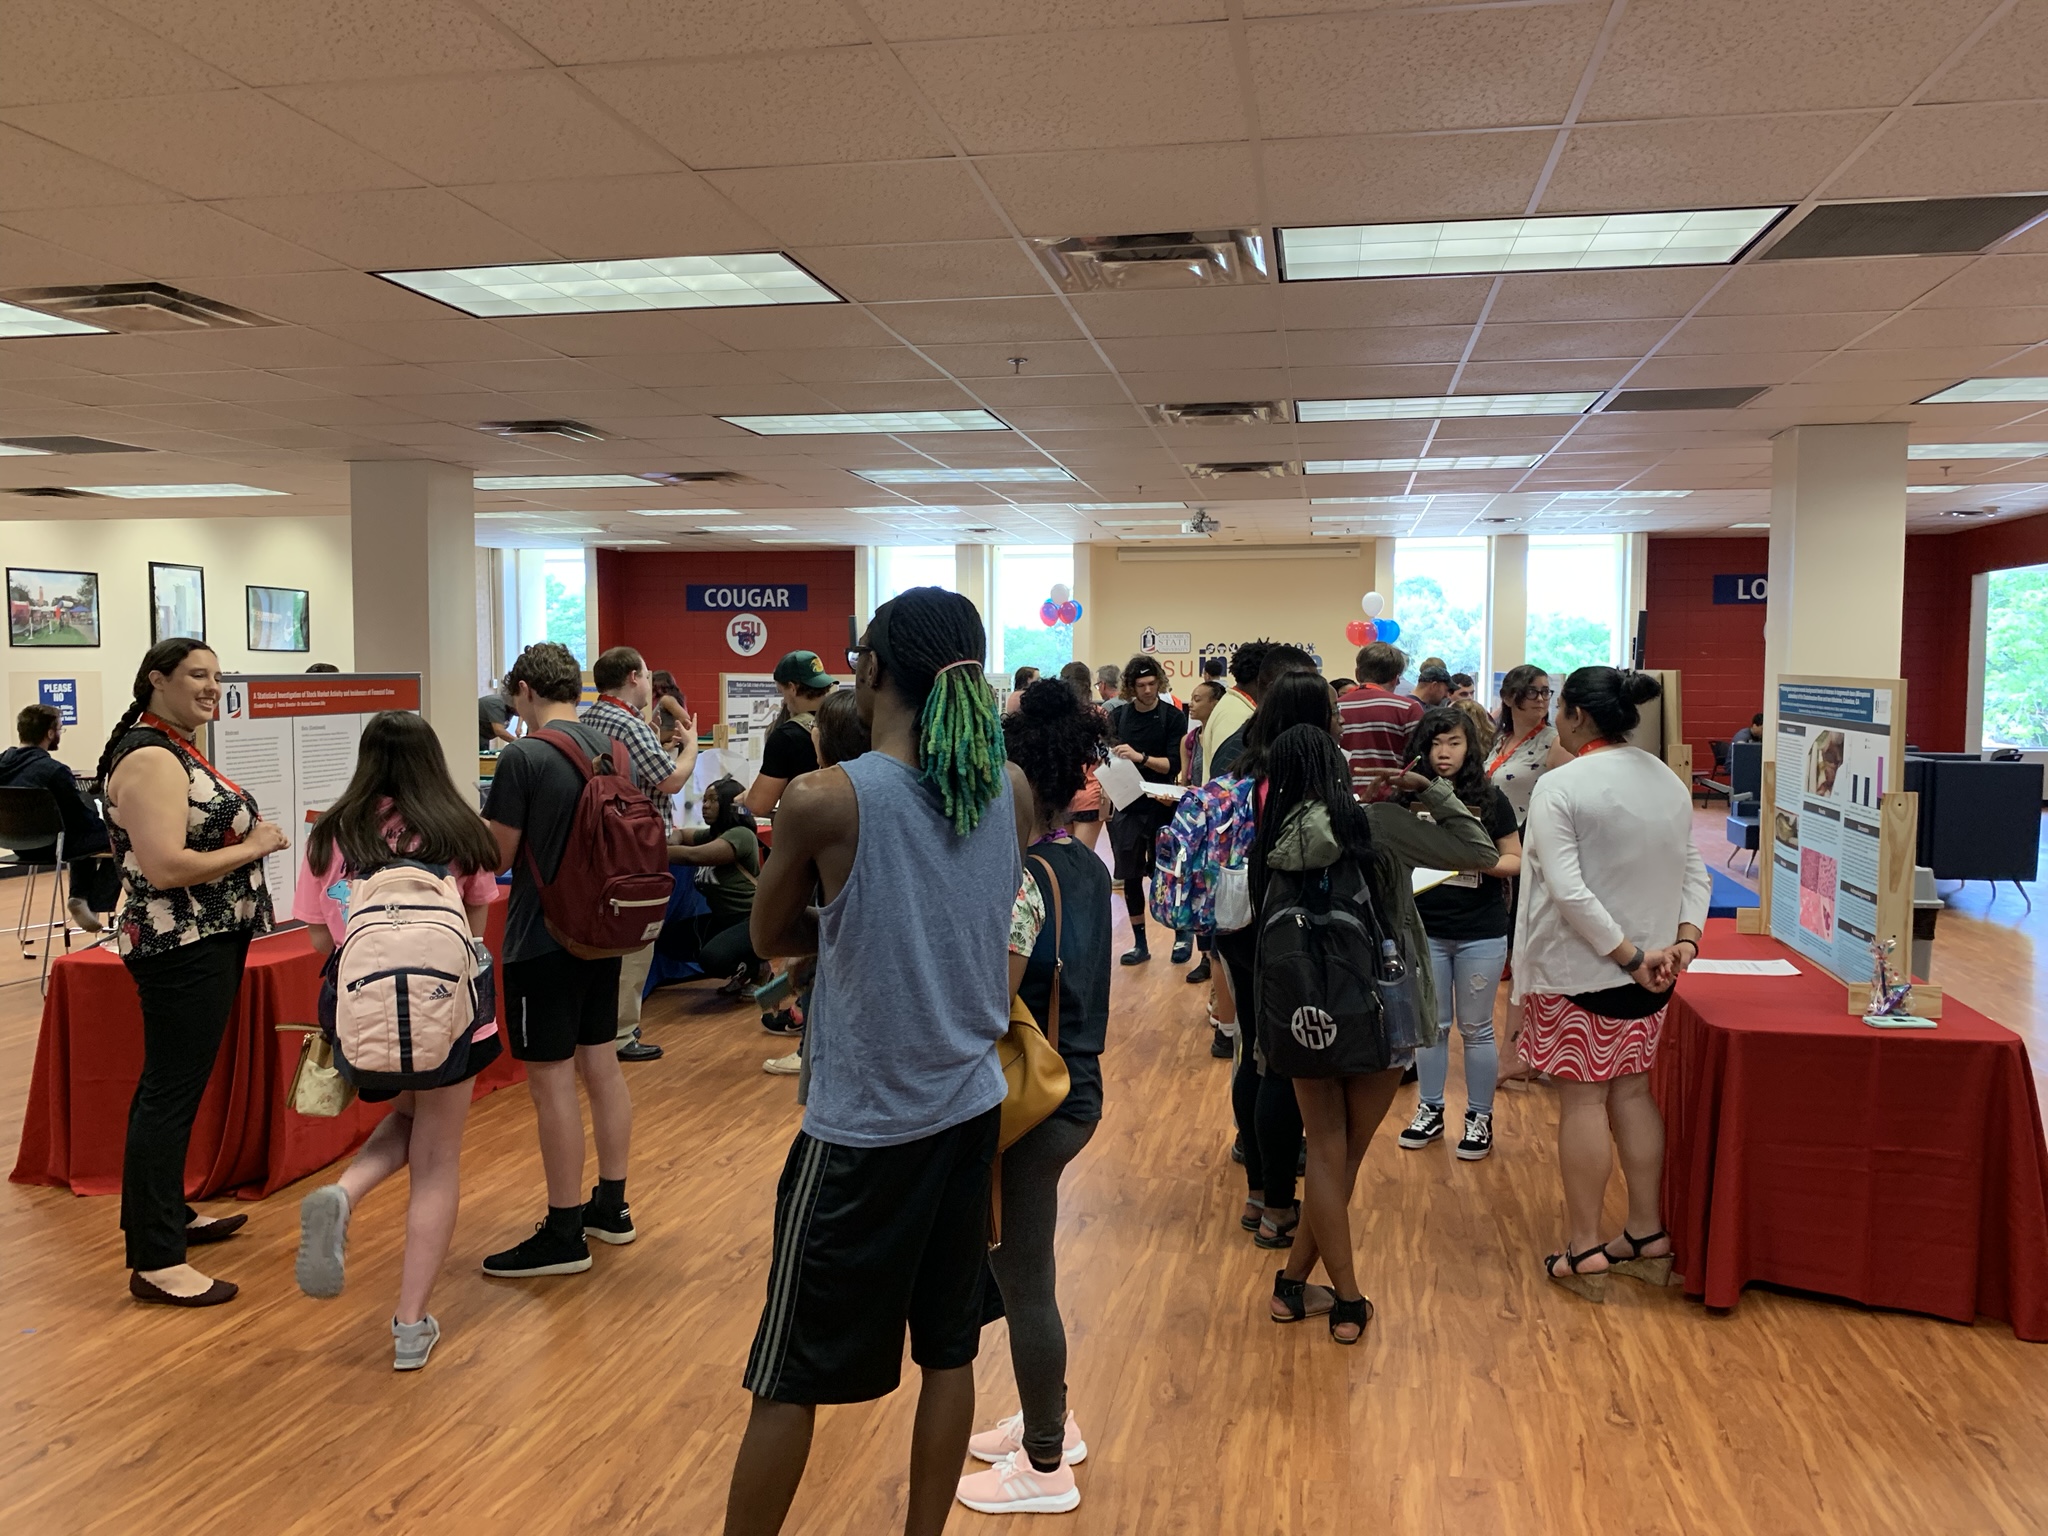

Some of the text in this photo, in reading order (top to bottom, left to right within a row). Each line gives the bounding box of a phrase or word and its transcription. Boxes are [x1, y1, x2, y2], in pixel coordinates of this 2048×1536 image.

[704, 588, 790, 608] COUGAR
[731, 621, 761, 637] CSU
[1163, 660, 1194, 678] su
[43, 683, 73, 693] PLEASE
[53, 692, 64, 702] NO
[429, 992, 453, 1001] adidas
[1291, 1005, 1338, 1050] BSS
